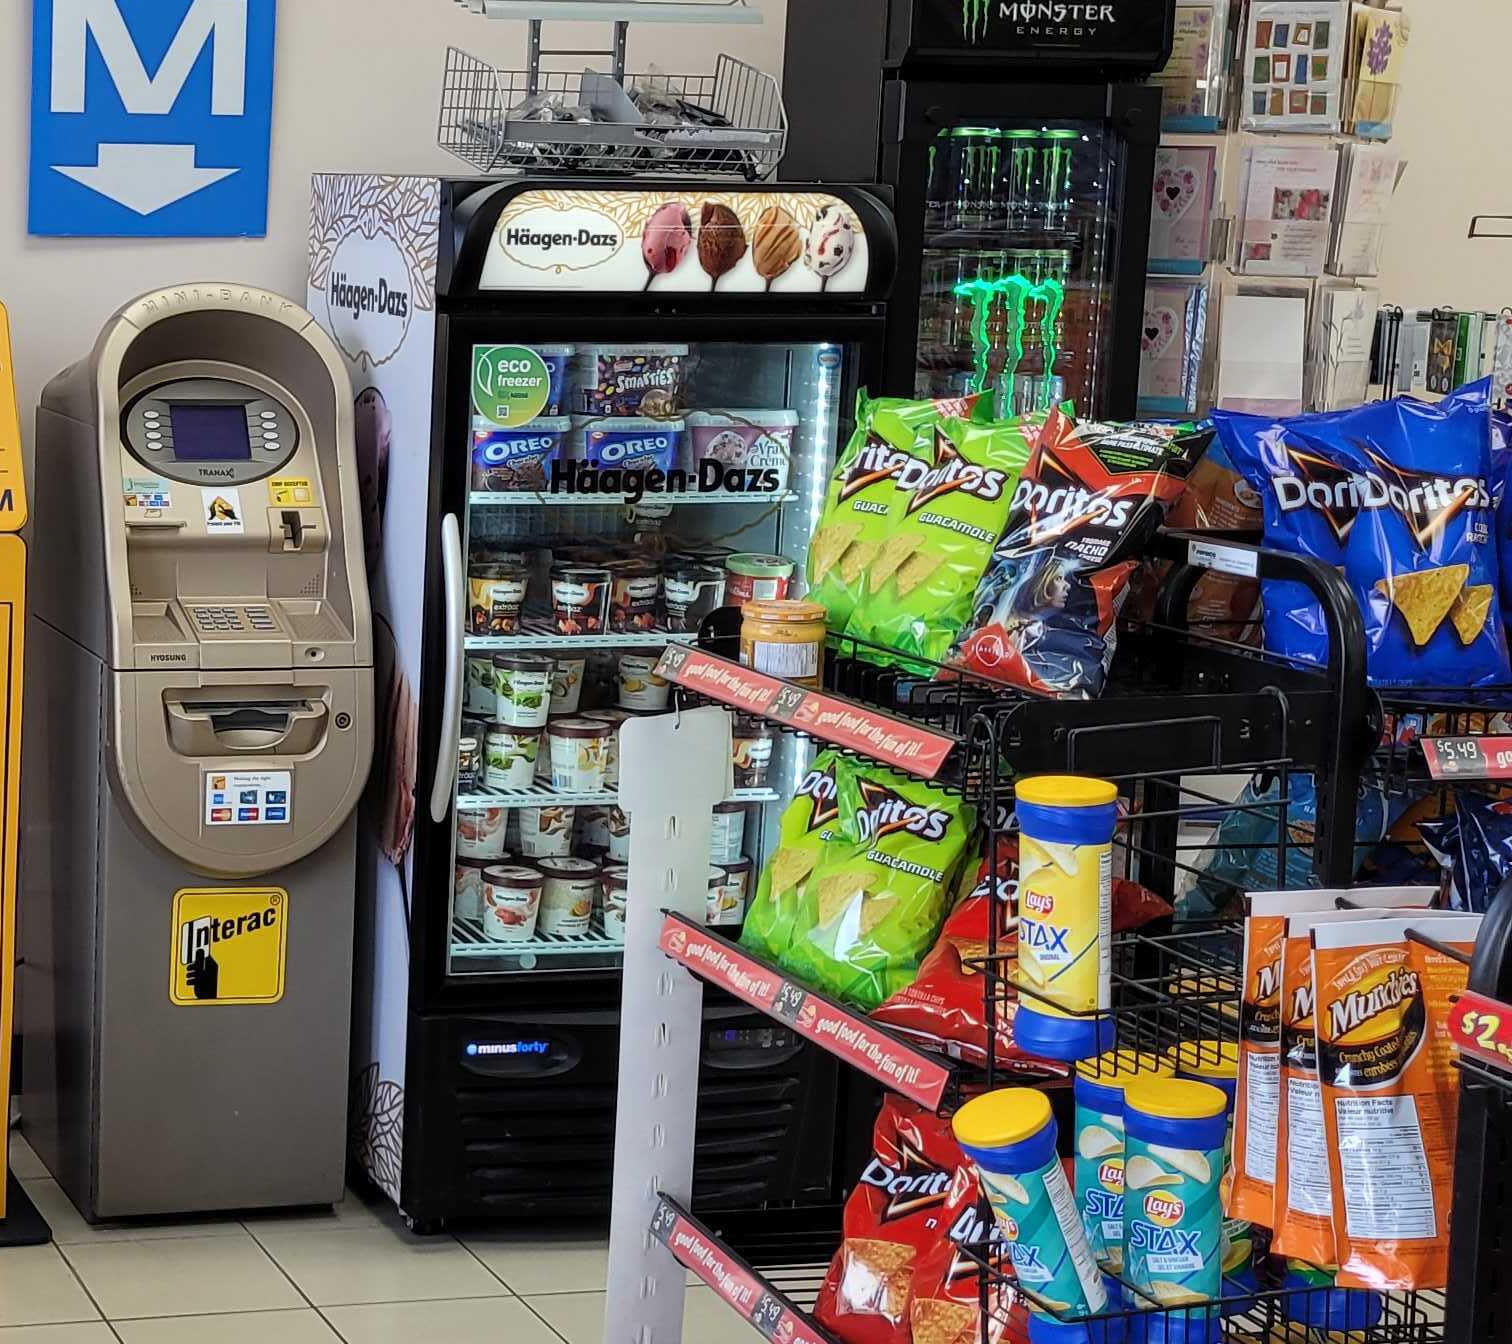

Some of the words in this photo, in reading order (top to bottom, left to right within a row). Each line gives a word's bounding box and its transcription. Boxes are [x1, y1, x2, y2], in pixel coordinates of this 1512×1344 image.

[999, 2, 1116, 24] MONSTER
[1016, 25, 1098, 36] ENERGY
[506, 227, 618, 253] Häagen-Dazs
[330, 271, 408, 319] Häagen-Dazs
[497, 359, 531, 373] eco
[497, 374, 543, 388] freezer
[486, 436, 553, 462] OREO
[601, 436, 668, 461] OREO
[198, 468, 231, 478] TRANAX
[549, 458, 780, 504] Häagen-Dazs
[895, 458, 1007, 501] Doritos
[1365, 471, 1491, 508] Doritos
[1010, 479, 1134, 528] Doritos
[918, 511, 997, 544] GUACAMOLE
[1065, 540, 1109, 556] NACHO
[150, 654, 187, 662] HYOSUNG
[1437, 738, 1478, 760] $5.49
[857, 799, 954, 842] Doritos
[866, 849, 944, 883] GUACAMOLE
[1025, 891, 1053, 912] Lay's
[1020, 918, 1070, 954] STAX
[1329, 967, 1418, 1042] Munchies
[814, 1018, 839, 1038] good
[838, 1025, 858, 1047] food
[477, 1040, 550, 1054] minusforty
[1146, 1196, 1183, 1219] Lay's
[1131, 1220, 1202, 1256] STAX
